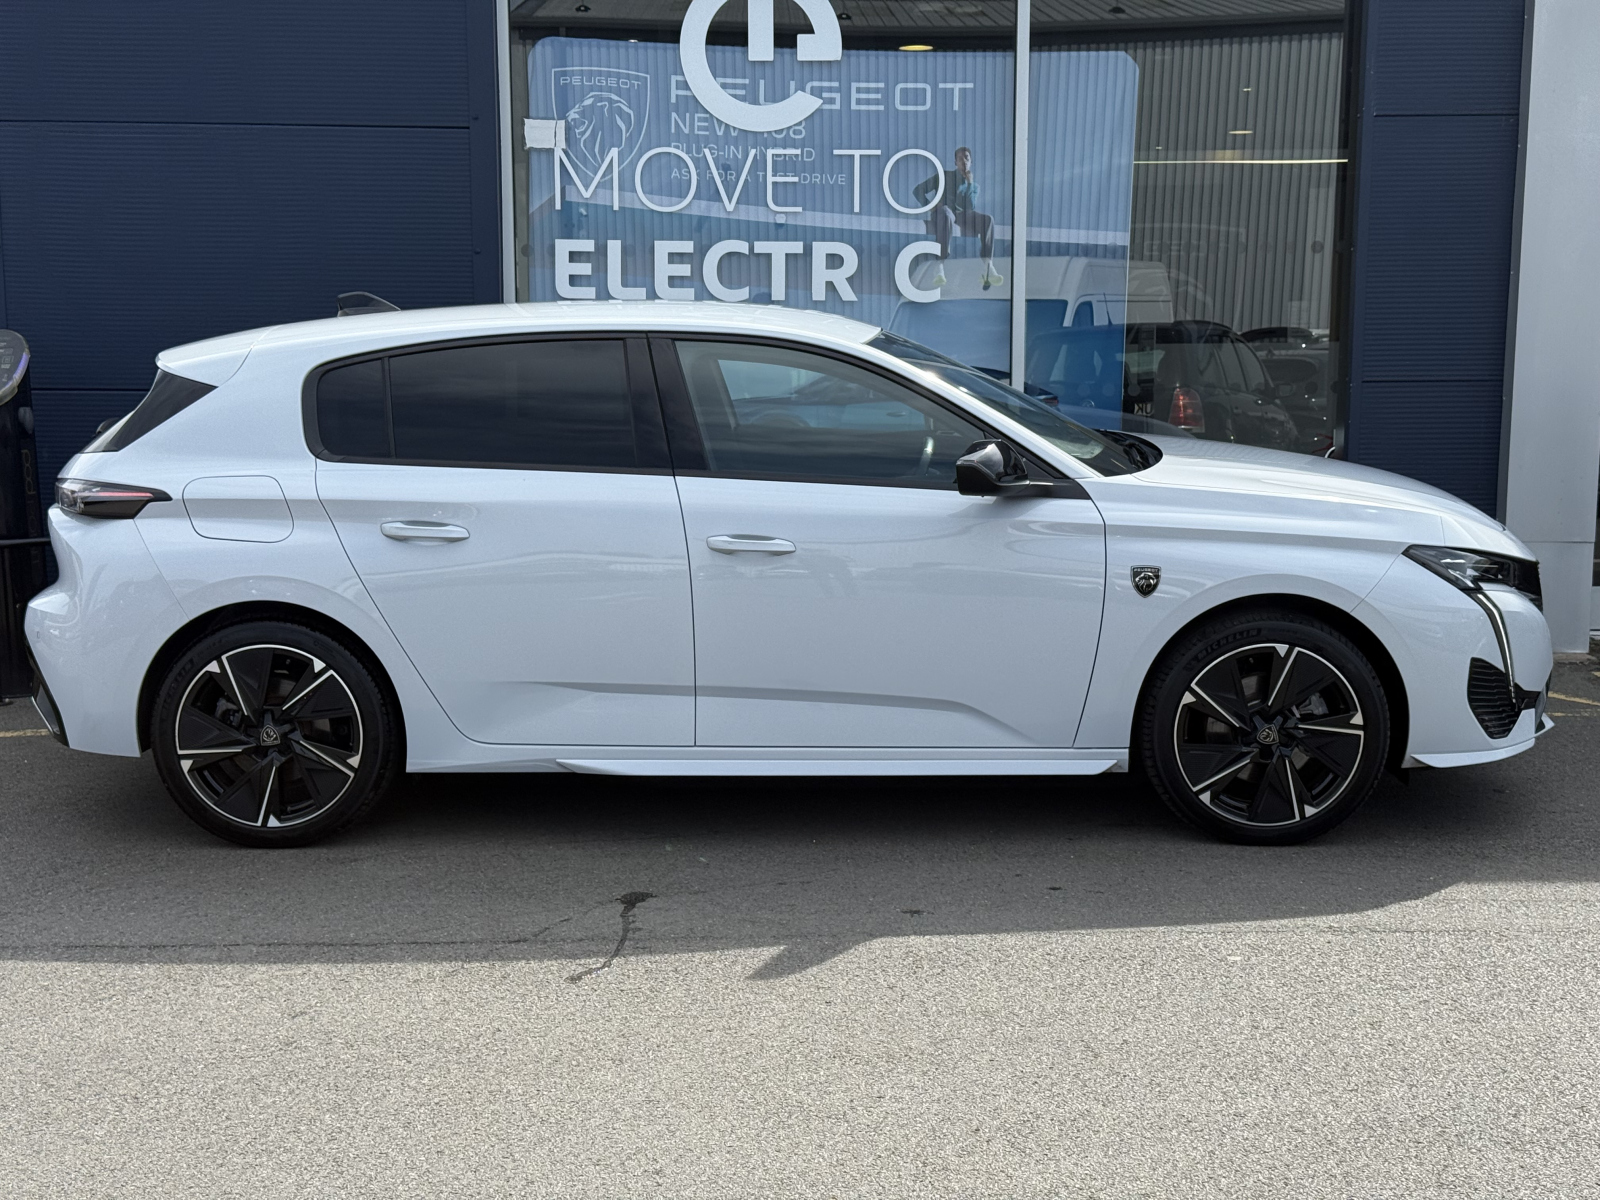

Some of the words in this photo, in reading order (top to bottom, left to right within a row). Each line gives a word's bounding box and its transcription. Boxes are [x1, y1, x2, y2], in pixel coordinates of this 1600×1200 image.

[560, 76, 641, 90] PEUGEOT
[671, 142, 742, 160] PLUG-IN
[748, 145, 816, 162] HYBRID
[554, 147, 803, 214] MOVE
[833, 149, 946, 214] TO
[706, 169, 736, 181] FOR
[756, 171, 795, 183] TT
[801, 173, 846, 185] DRIVE
